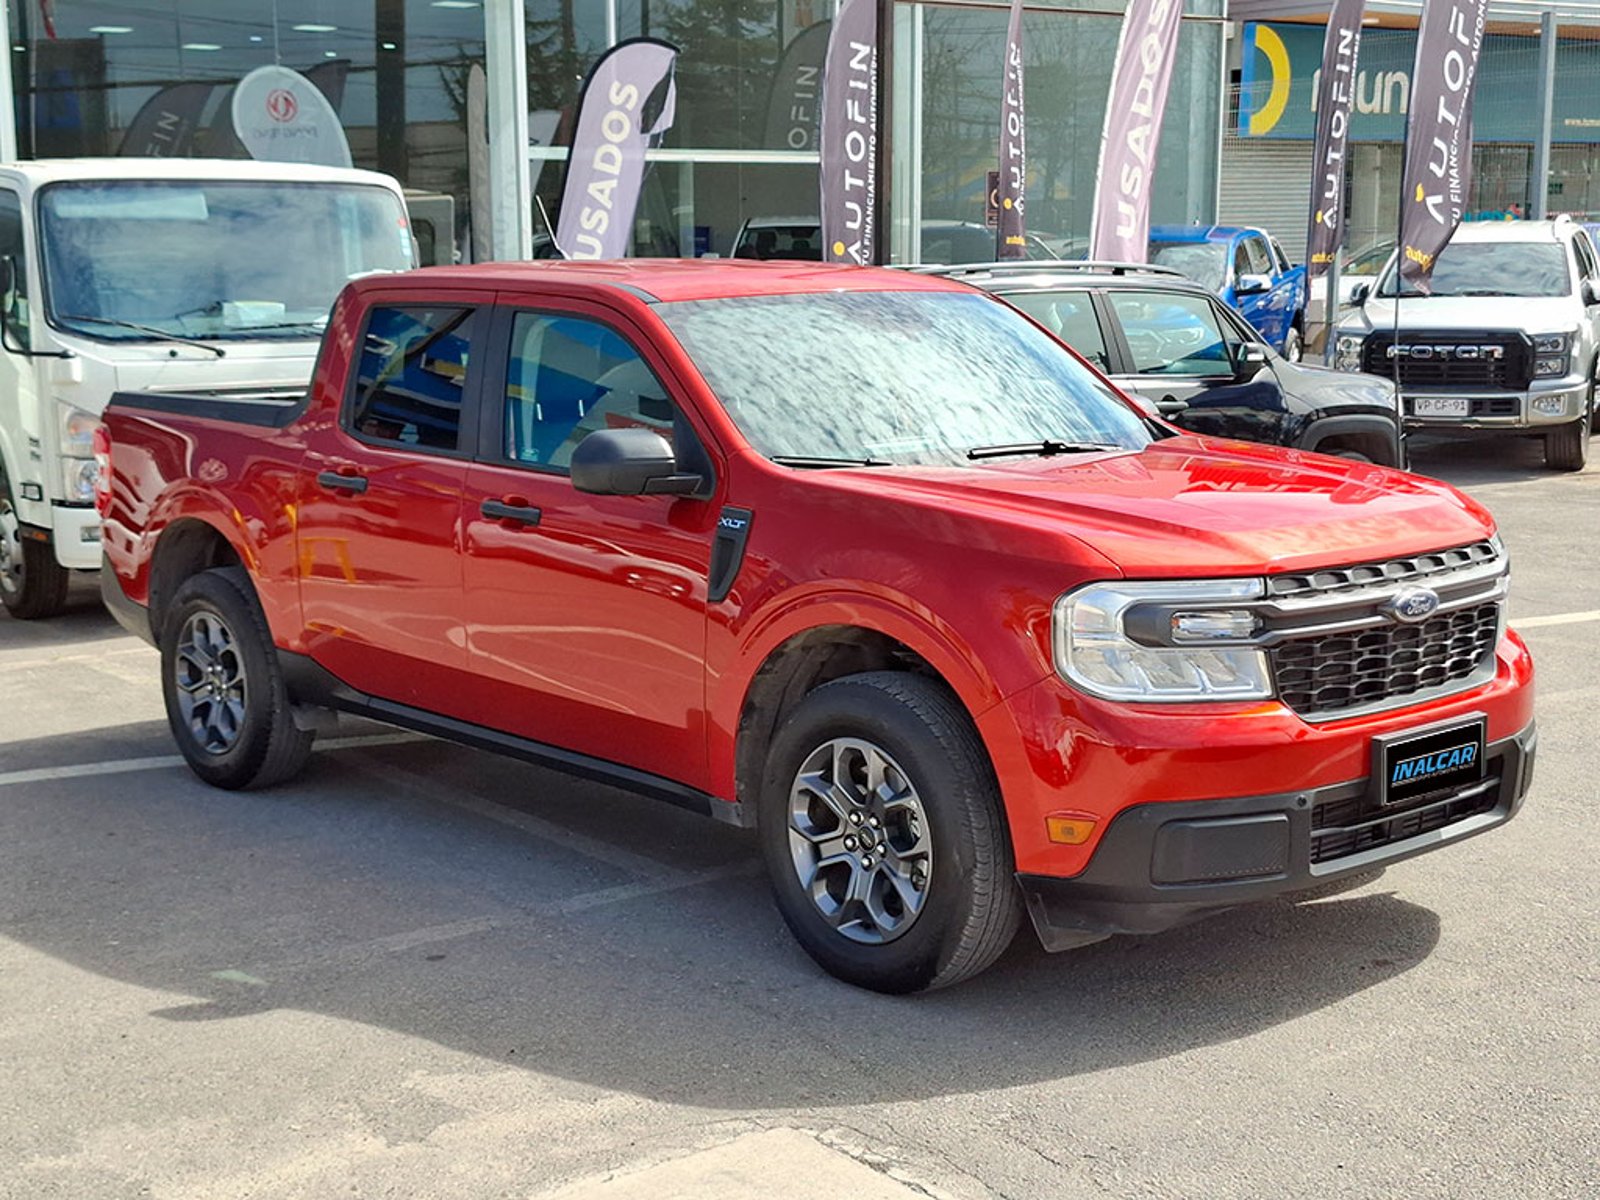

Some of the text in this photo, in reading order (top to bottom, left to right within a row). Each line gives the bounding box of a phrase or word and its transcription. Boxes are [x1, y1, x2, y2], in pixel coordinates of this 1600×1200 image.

[571, 80, 639, 260] USADOS
[845, 41, 871, 266] AUTOFIN
[1116, 0, 1168, 239] USADOS
[1322, 29, 1354, 229] AUTOFIN
[1425, 0, 1474, 224] AUTOF
[1386, 344, 1504, 359] FOTON
[718, 516, 746, 528] XLT
[1407, 596, 1431, 615] Ford
[1392, 746, 1474, 782] INALCAR
